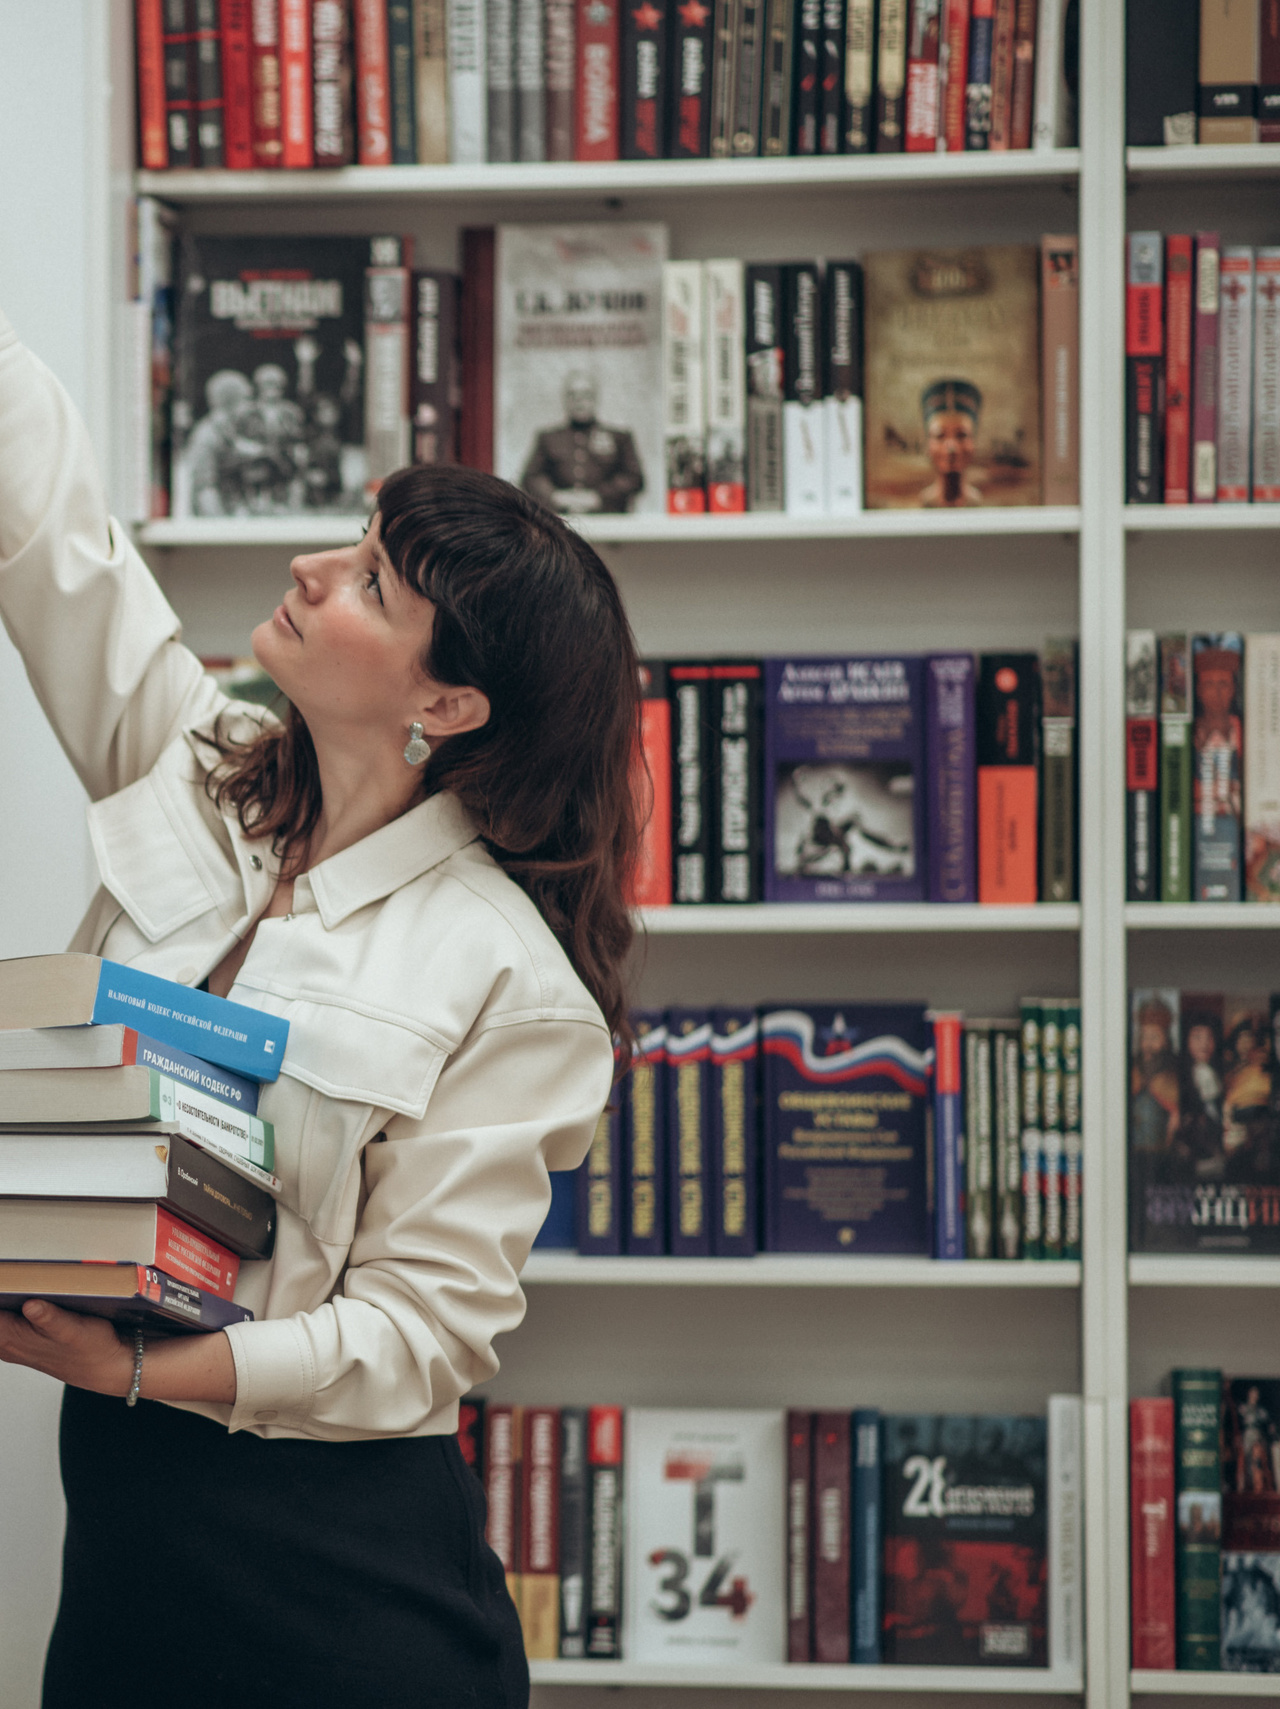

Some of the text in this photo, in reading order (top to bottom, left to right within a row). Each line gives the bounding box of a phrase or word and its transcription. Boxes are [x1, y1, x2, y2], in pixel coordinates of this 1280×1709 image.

[108, 989, 248, 1043] НАЛОГОВЫЙ КОДЕКС РОССИЙСКОЙ ФЕДЕРАЦИИ
[143, 1049, 242, 1101] ГРАЖДАНСКИЙ КОДЕКС РФ
[182, 1102, 220, 1127] НЕСОСТОЯТЕЛЬНОСТИ
[648, 1543, 756, 1624] 34
